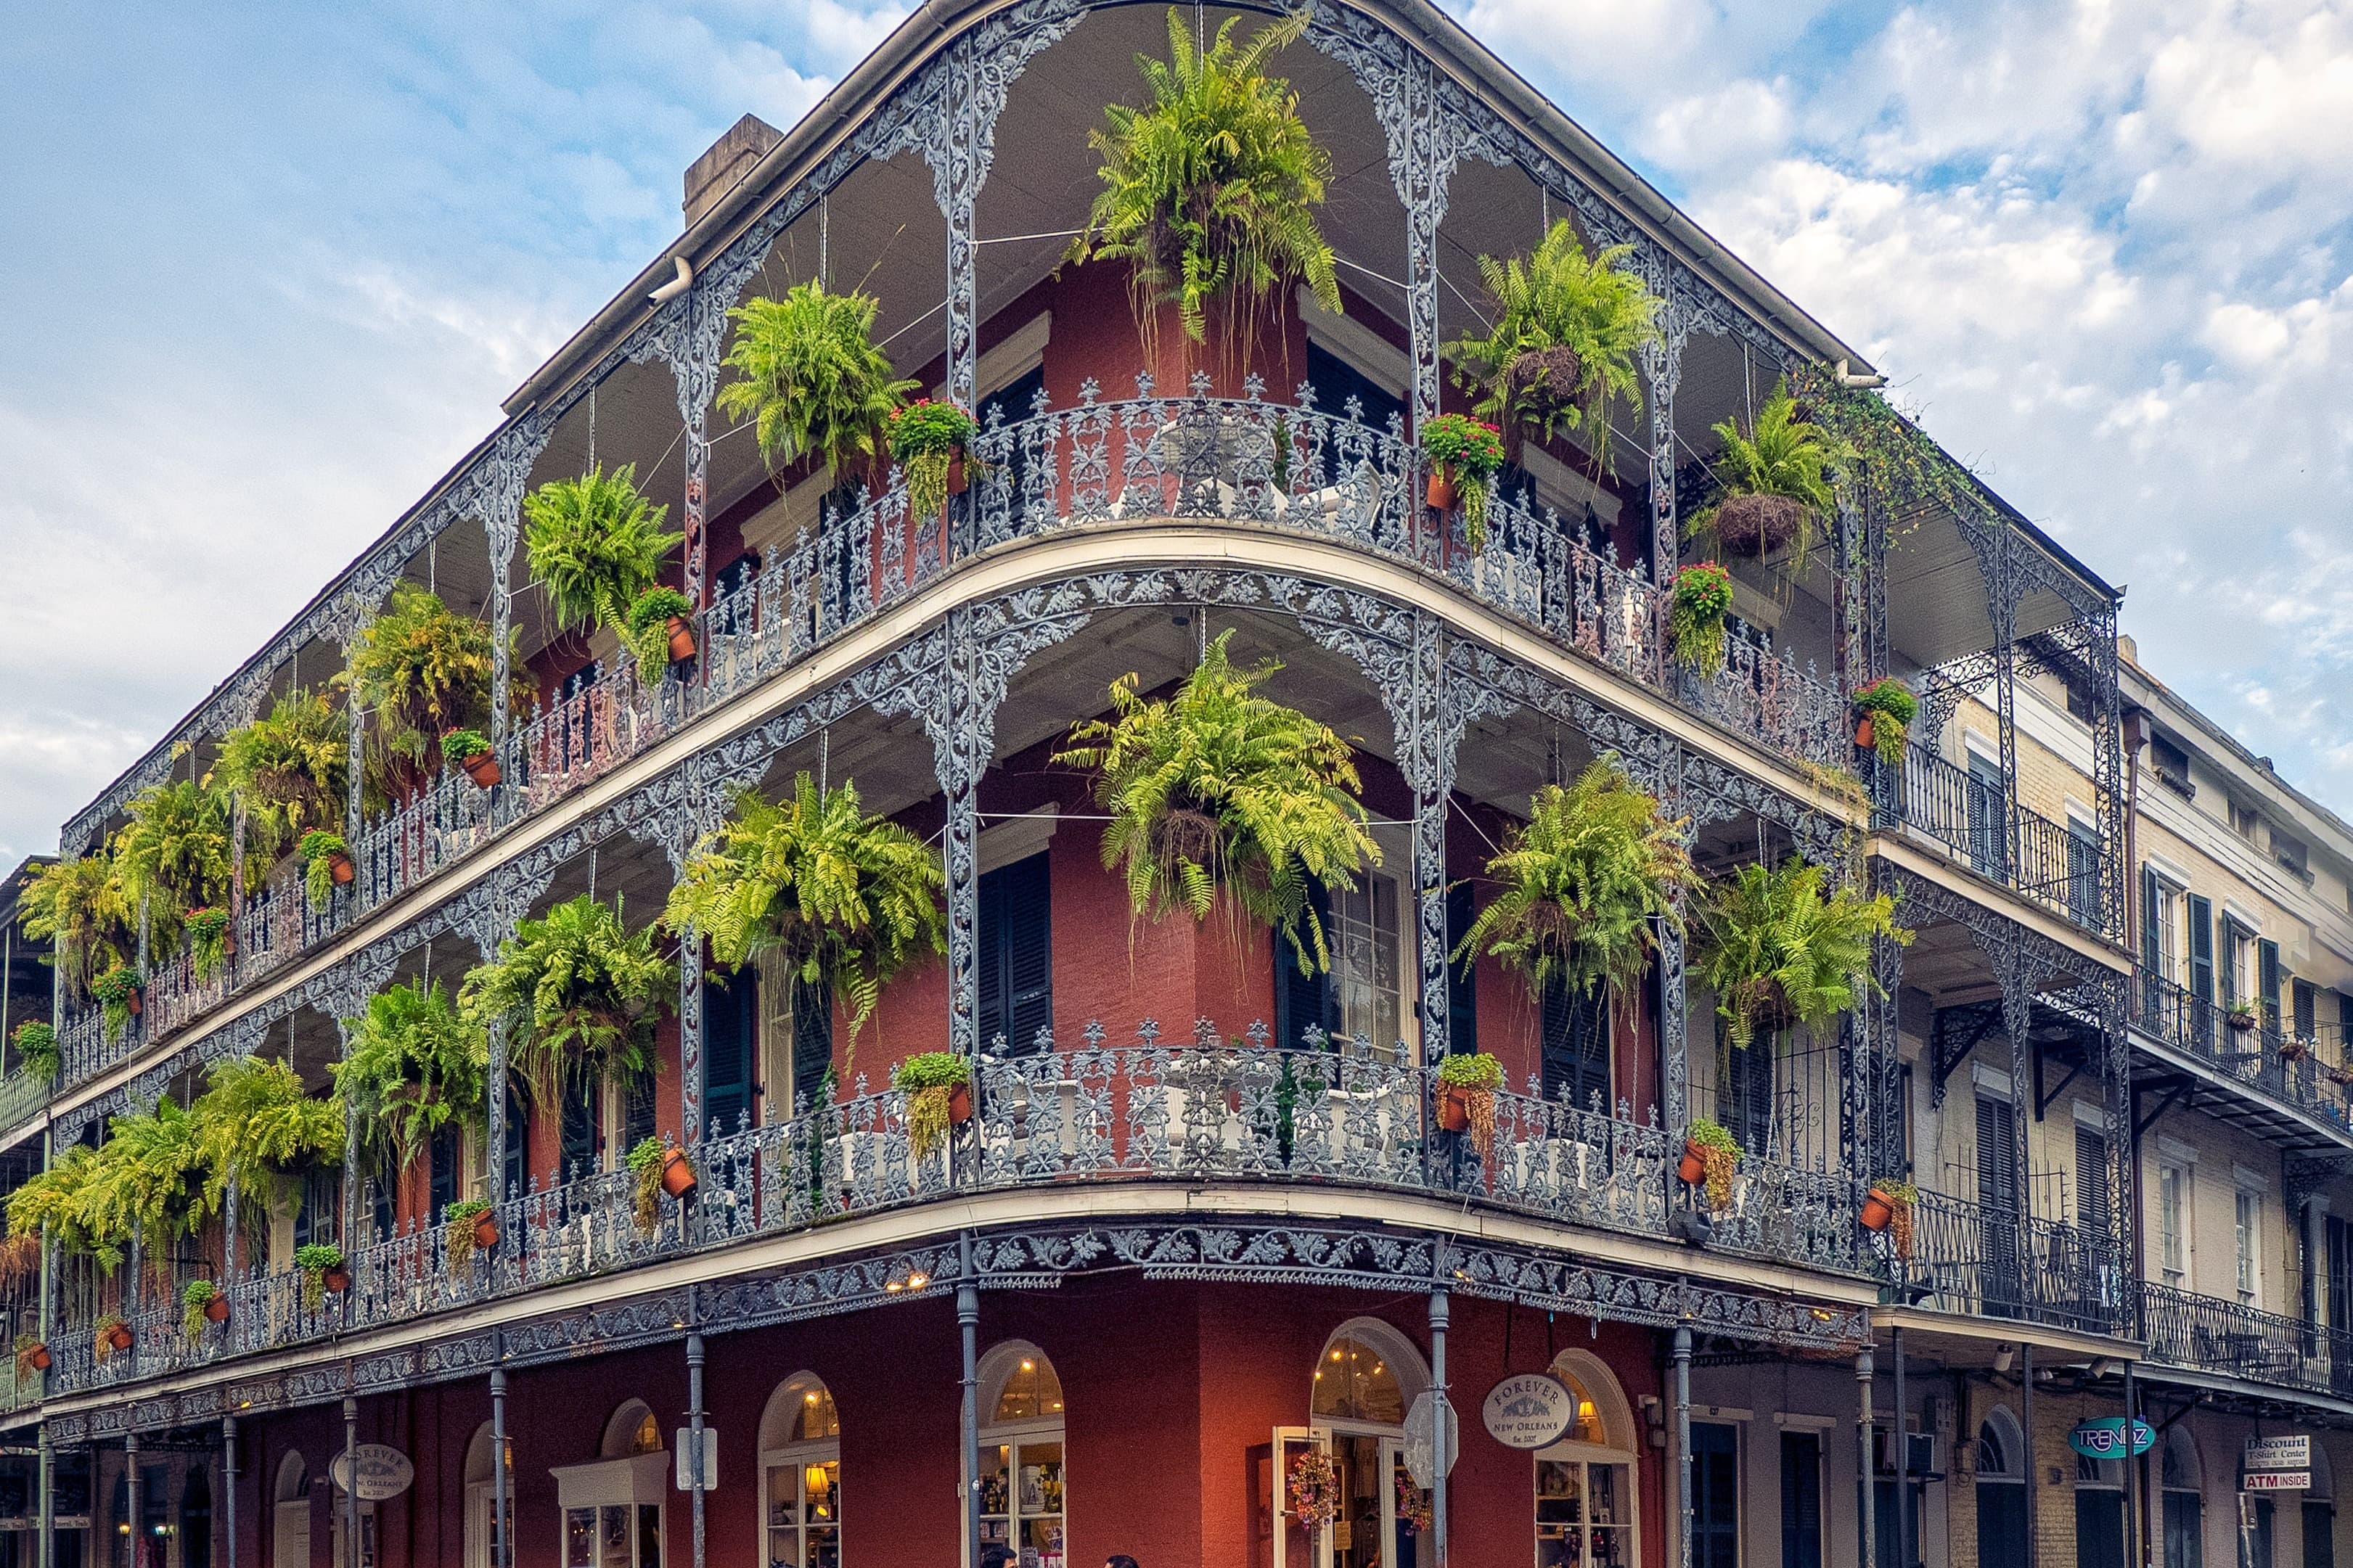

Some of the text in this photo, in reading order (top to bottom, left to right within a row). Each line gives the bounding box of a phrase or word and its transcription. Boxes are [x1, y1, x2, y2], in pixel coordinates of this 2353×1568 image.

[1494, 1380, 1559, 1406] FOREVER
[1494, 1422, 1558, 1432] NEW ORLEANS
[2248, 1437, 2306, 1450] Discount
[343, 1450, 402, 1467] OREVER
[2248, 1450, 2306, 1459] T-Shirt Center
[2246, 1475, 2307, 1488] ATM INSIDE
